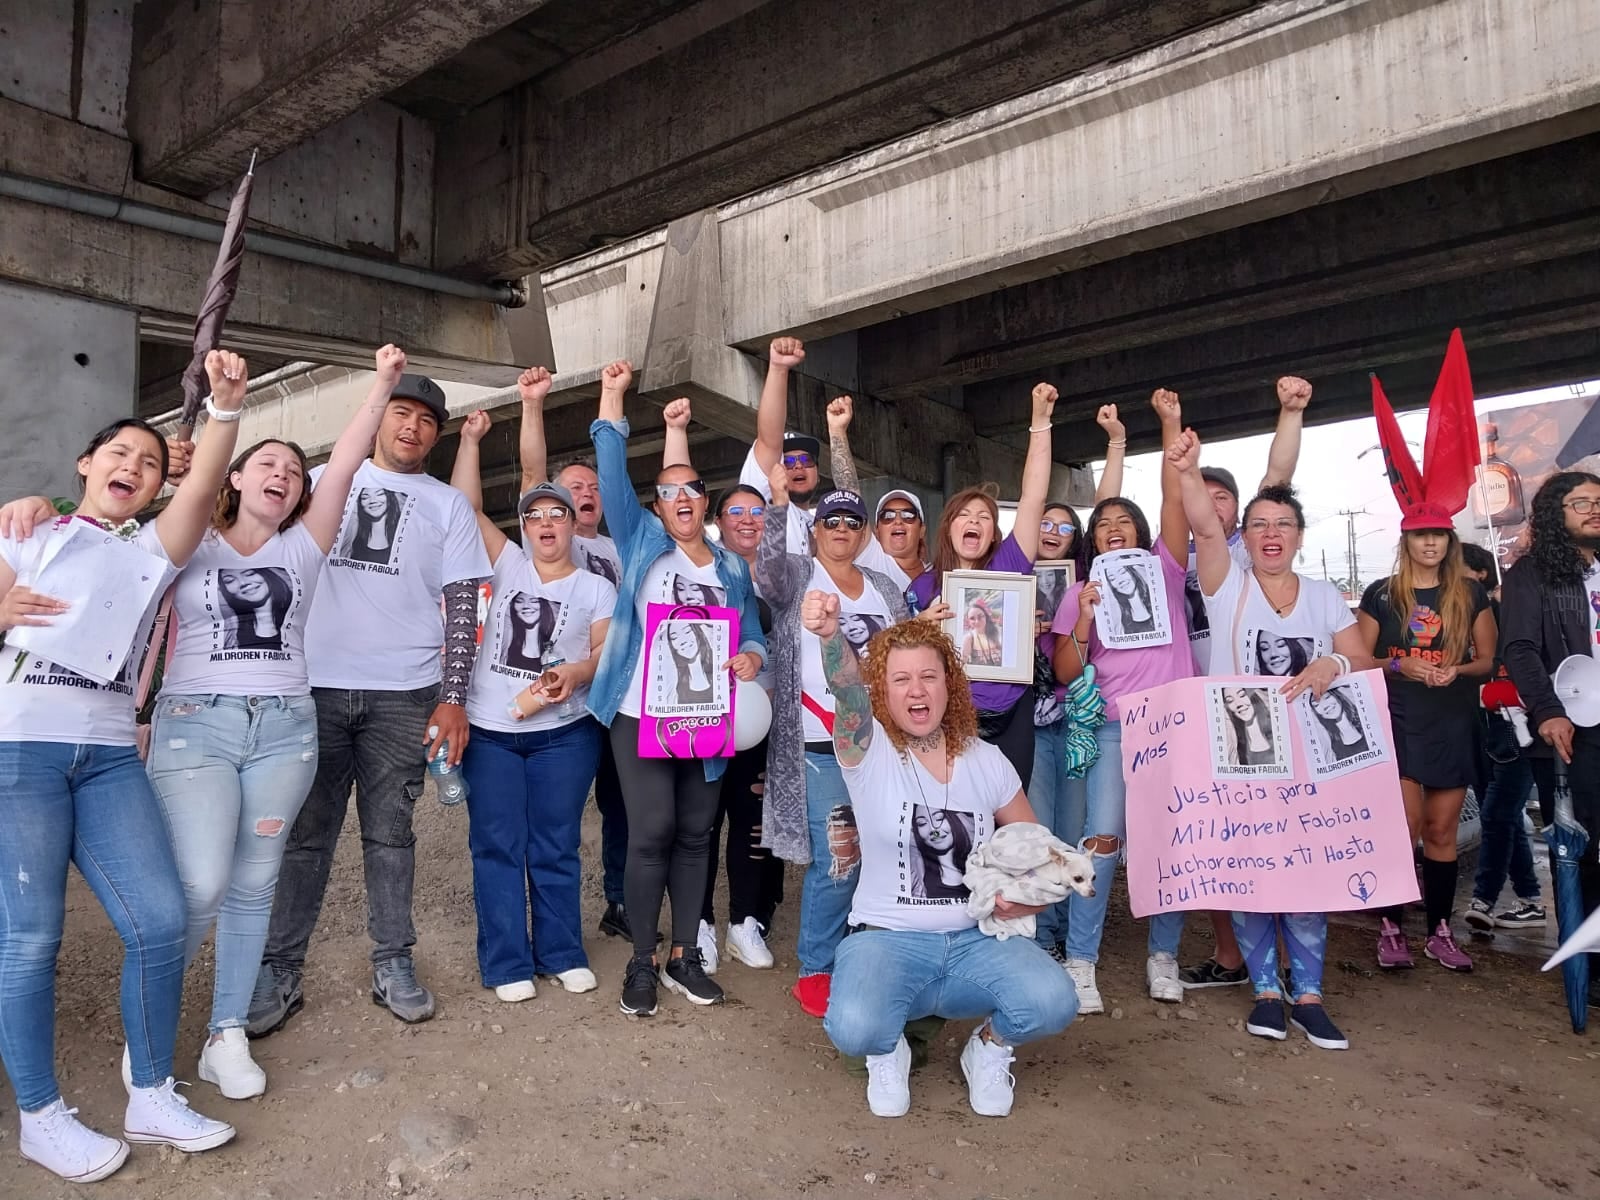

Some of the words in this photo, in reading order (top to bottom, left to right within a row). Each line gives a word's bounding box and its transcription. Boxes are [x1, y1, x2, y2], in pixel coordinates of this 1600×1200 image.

[823, 490, 843, 505] COSTA
[393, 497, 416, 563] JUSTICIA
[328, 558, 367, 571] MILDROREN
[367, 563, 400, 576] FABIOLA
[203, 569, 220, 649] EXIGIMOS
[1141, 631, 1167, 641] FABIOLA
[209, 651, 261, 663] MILDROREN
[263, 651, 293, 662] FABIOLA
[490, 663, 522, 679] MILDROREN
[23, 674, 98, 690] MILDROREN
[654, 705, 694, 714] MILDROREN
[696, 703, 726, 712] FABIOLA
[1126, 697, 1149, 726] Ni
[1354, 682, 1377, 747] JUSTICIA
[1212, 688, 1225, 763] EXIGIMOS
[1271, 688, 1285, 763] JUSTICIA
[1131, 740, 1168, 773] Mas
[1217, 766, 1257, 775] MILDROREN
[1258, 765, 1289, 774] FABIOLA
[1316, 758, 1355, 775] MILDROREN
[1354, 748, 1383, 764] FABIOLA
[1167, 781, 1268, 814] Justicia
[1276, 782, 1318, 805] para
[1298, 806, 1372, 834] Fabiola
[897, 801, 908, 893] EXIGIMOS
[1157, 853, 1277, 884] Lucharemos
[1324, 835, 1375, 864] Hasta
